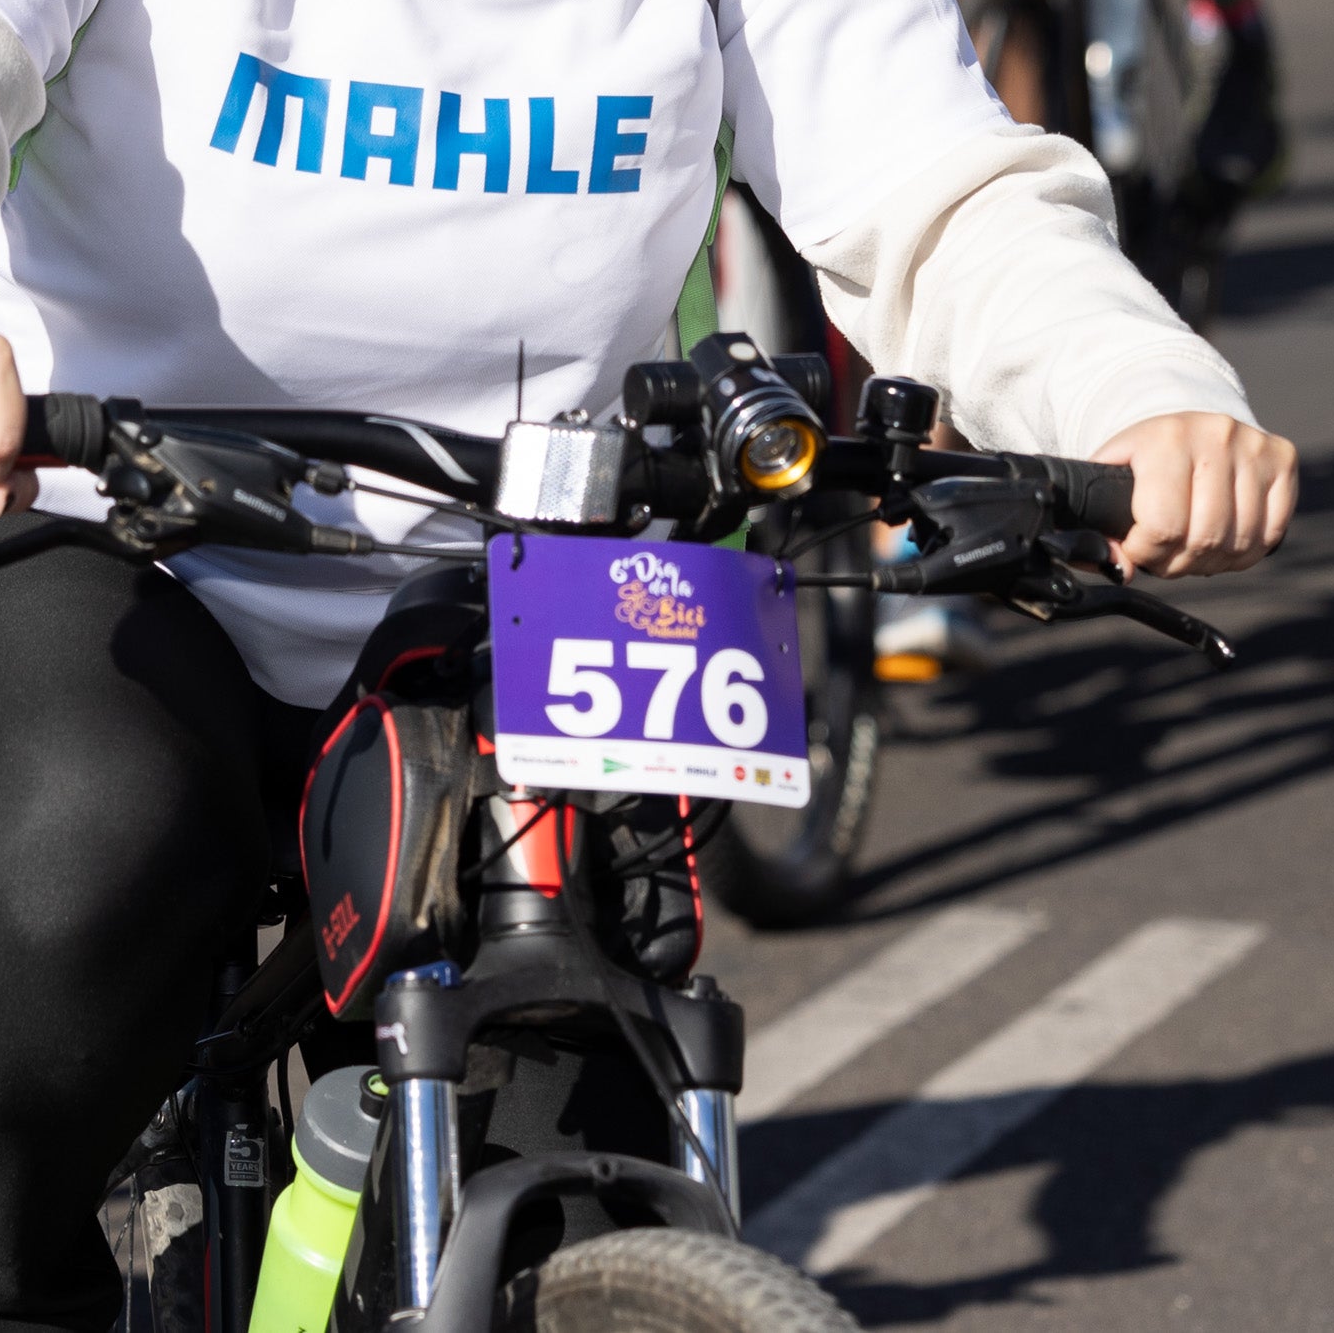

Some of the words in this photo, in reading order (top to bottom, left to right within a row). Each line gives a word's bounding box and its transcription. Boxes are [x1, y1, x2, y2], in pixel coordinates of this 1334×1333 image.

[209, 51, 654, 195] MAHLE
[654, 596, 707, 628] Bici
[544, 638, 768, 749] 576
[229, 1162, 260, 1173] YEARS
